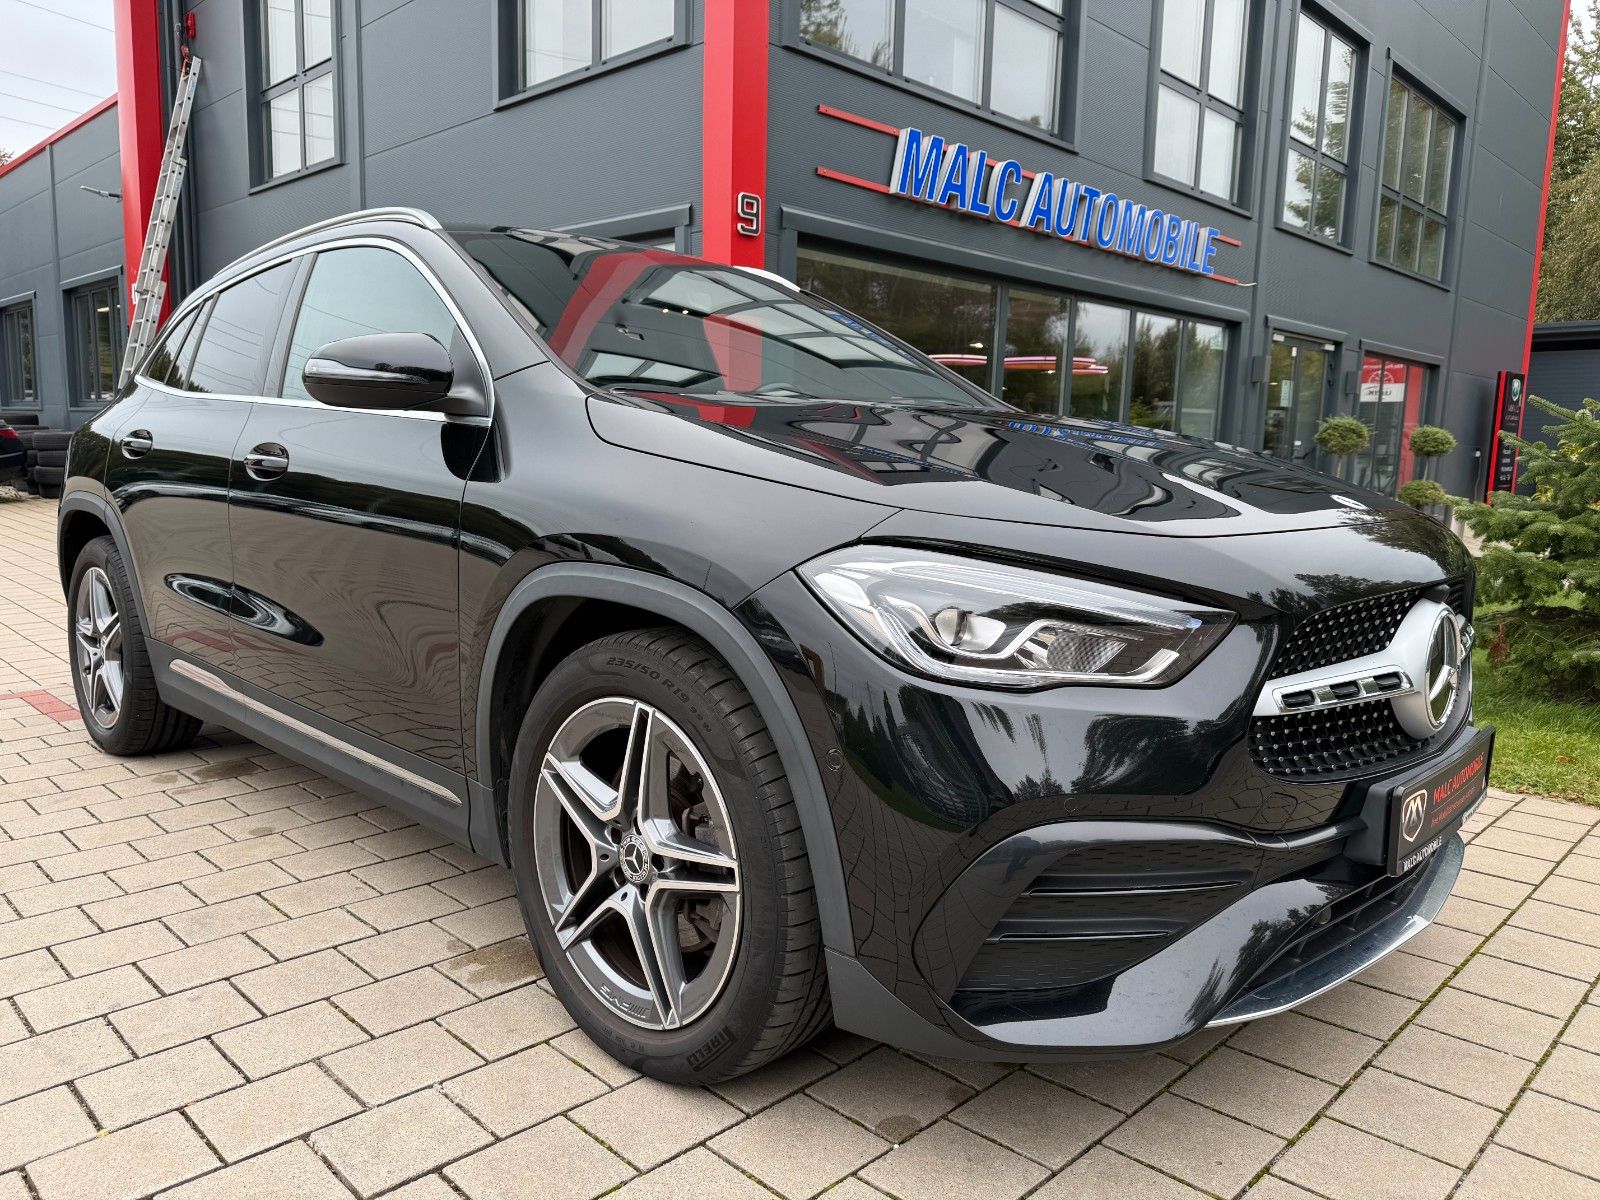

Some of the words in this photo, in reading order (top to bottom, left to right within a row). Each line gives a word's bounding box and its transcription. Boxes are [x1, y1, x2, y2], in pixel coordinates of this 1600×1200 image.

[737, 191, 761, 237] 9
[891, 126, 1022, 223] MALC
[1020, 171, 1220, 276] AUTOMOBILE
[606, 656, 661, 680] 235/50
[662, 678, 690, 704] R19
[1433, 778, 1453, 806] MALC
[687, 1026, 735, 1072] PIRELLI
